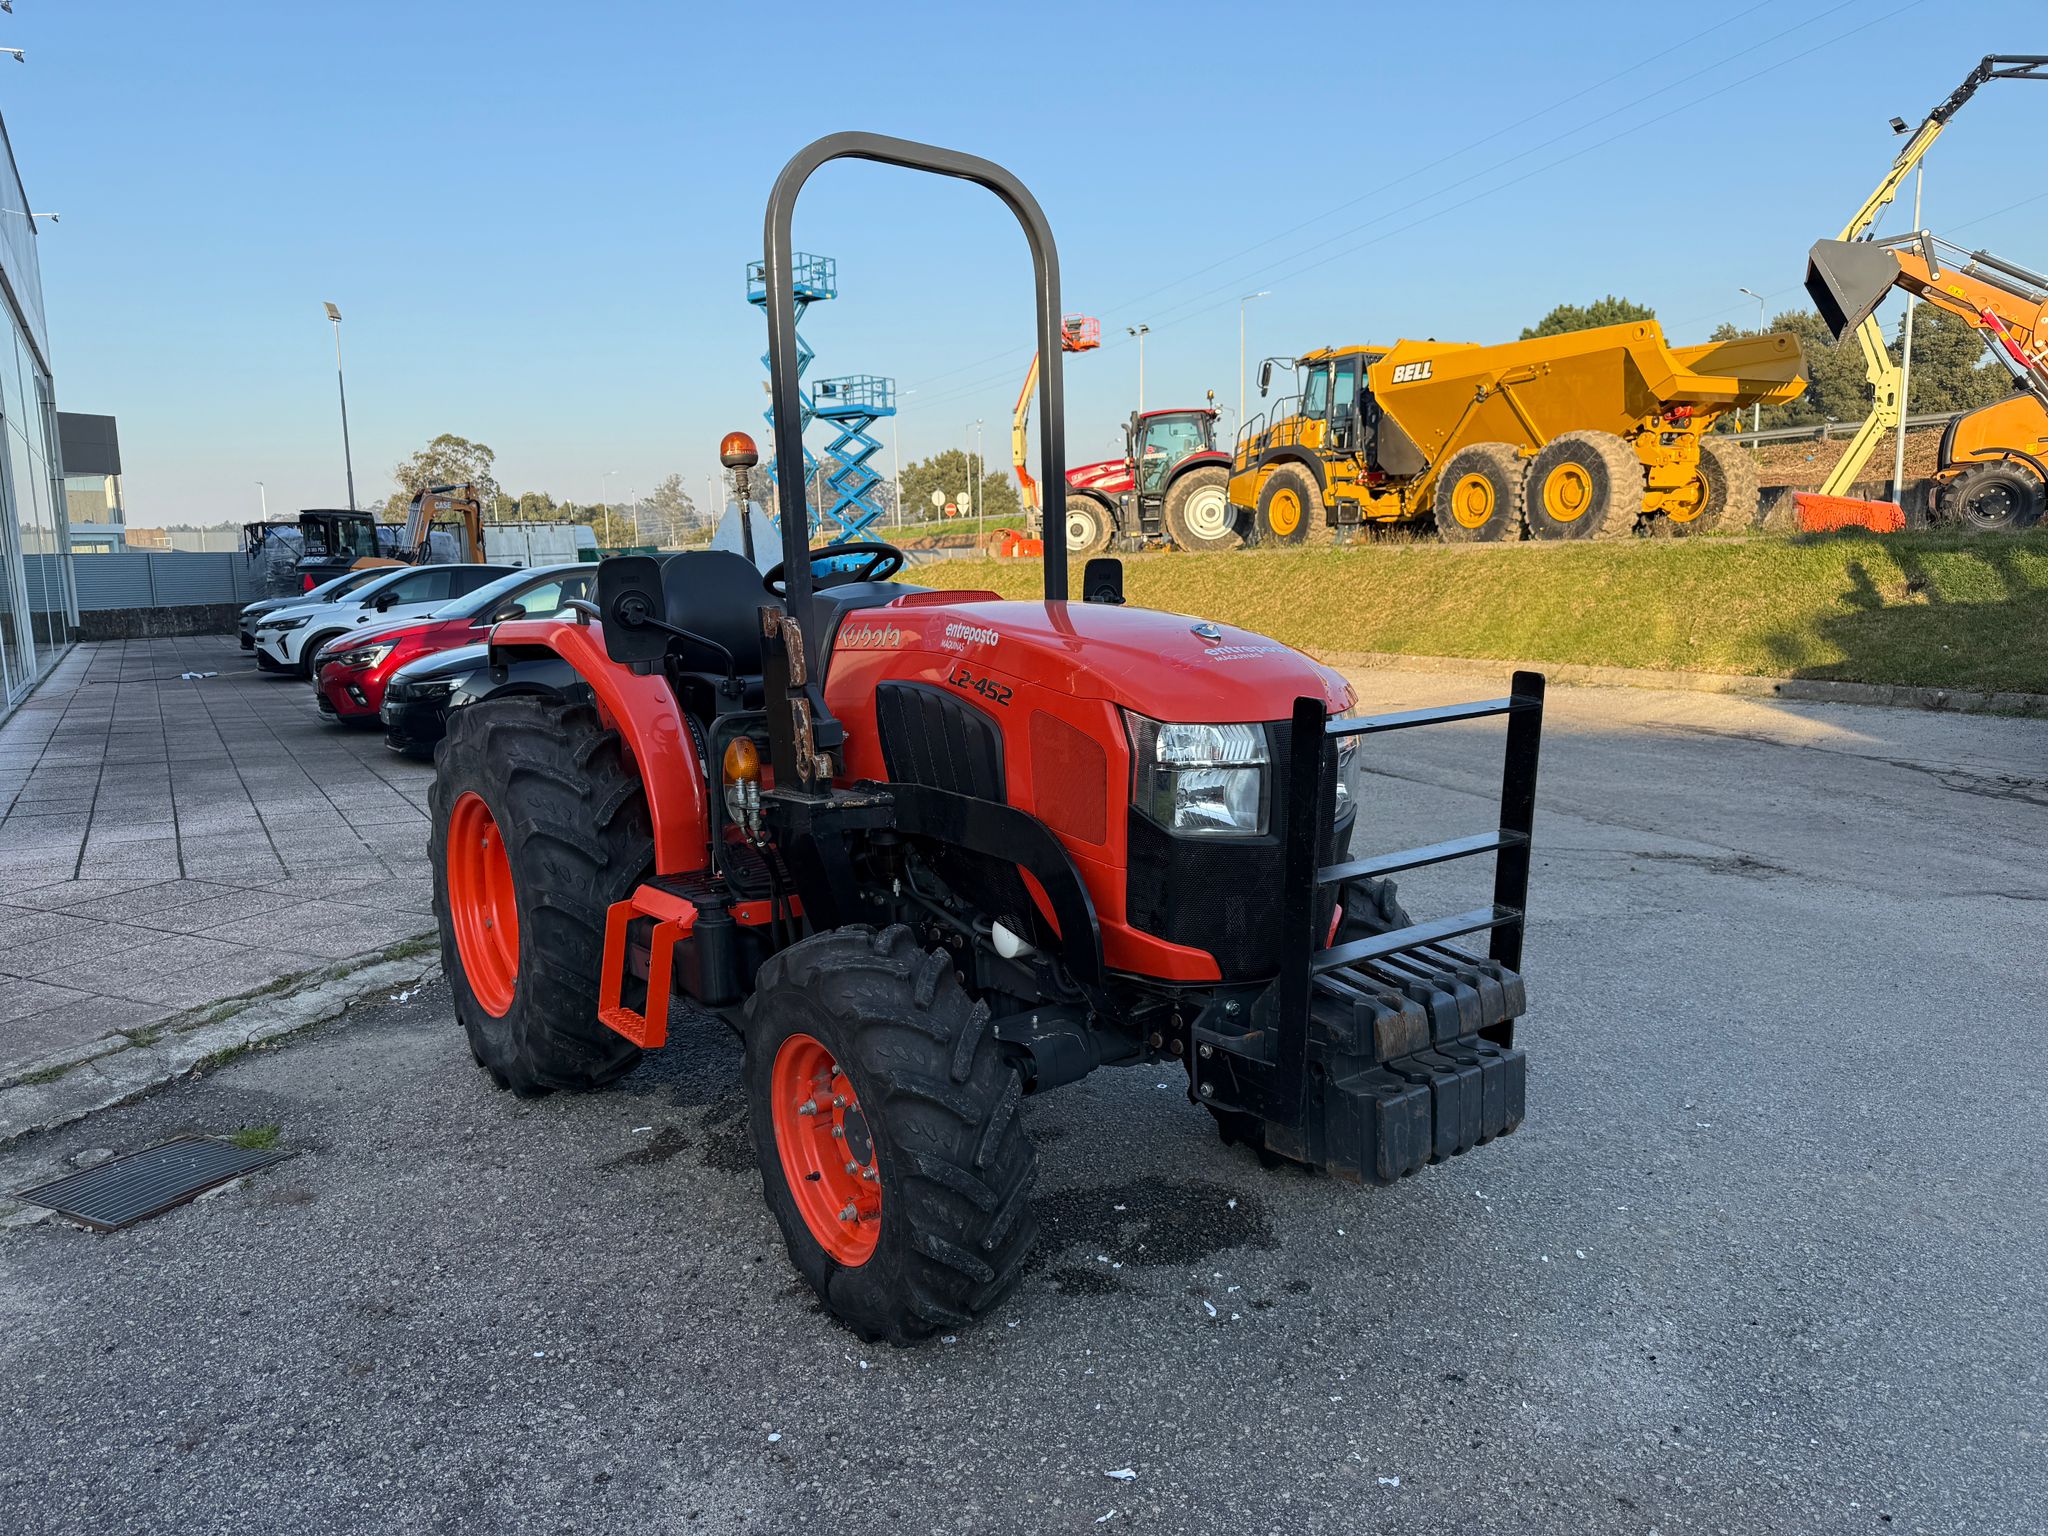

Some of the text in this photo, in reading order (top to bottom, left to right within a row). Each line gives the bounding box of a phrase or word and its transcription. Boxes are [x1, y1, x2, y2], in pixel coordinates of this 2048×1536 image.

[1392, 361, 1432, 384] BELL
[434, 501, 452, 509] CASE
[838, 622, 901, 648] Kubota
[945, 622, 999, 647] entreposto
[949, 667, 1013, 707] L2-452
